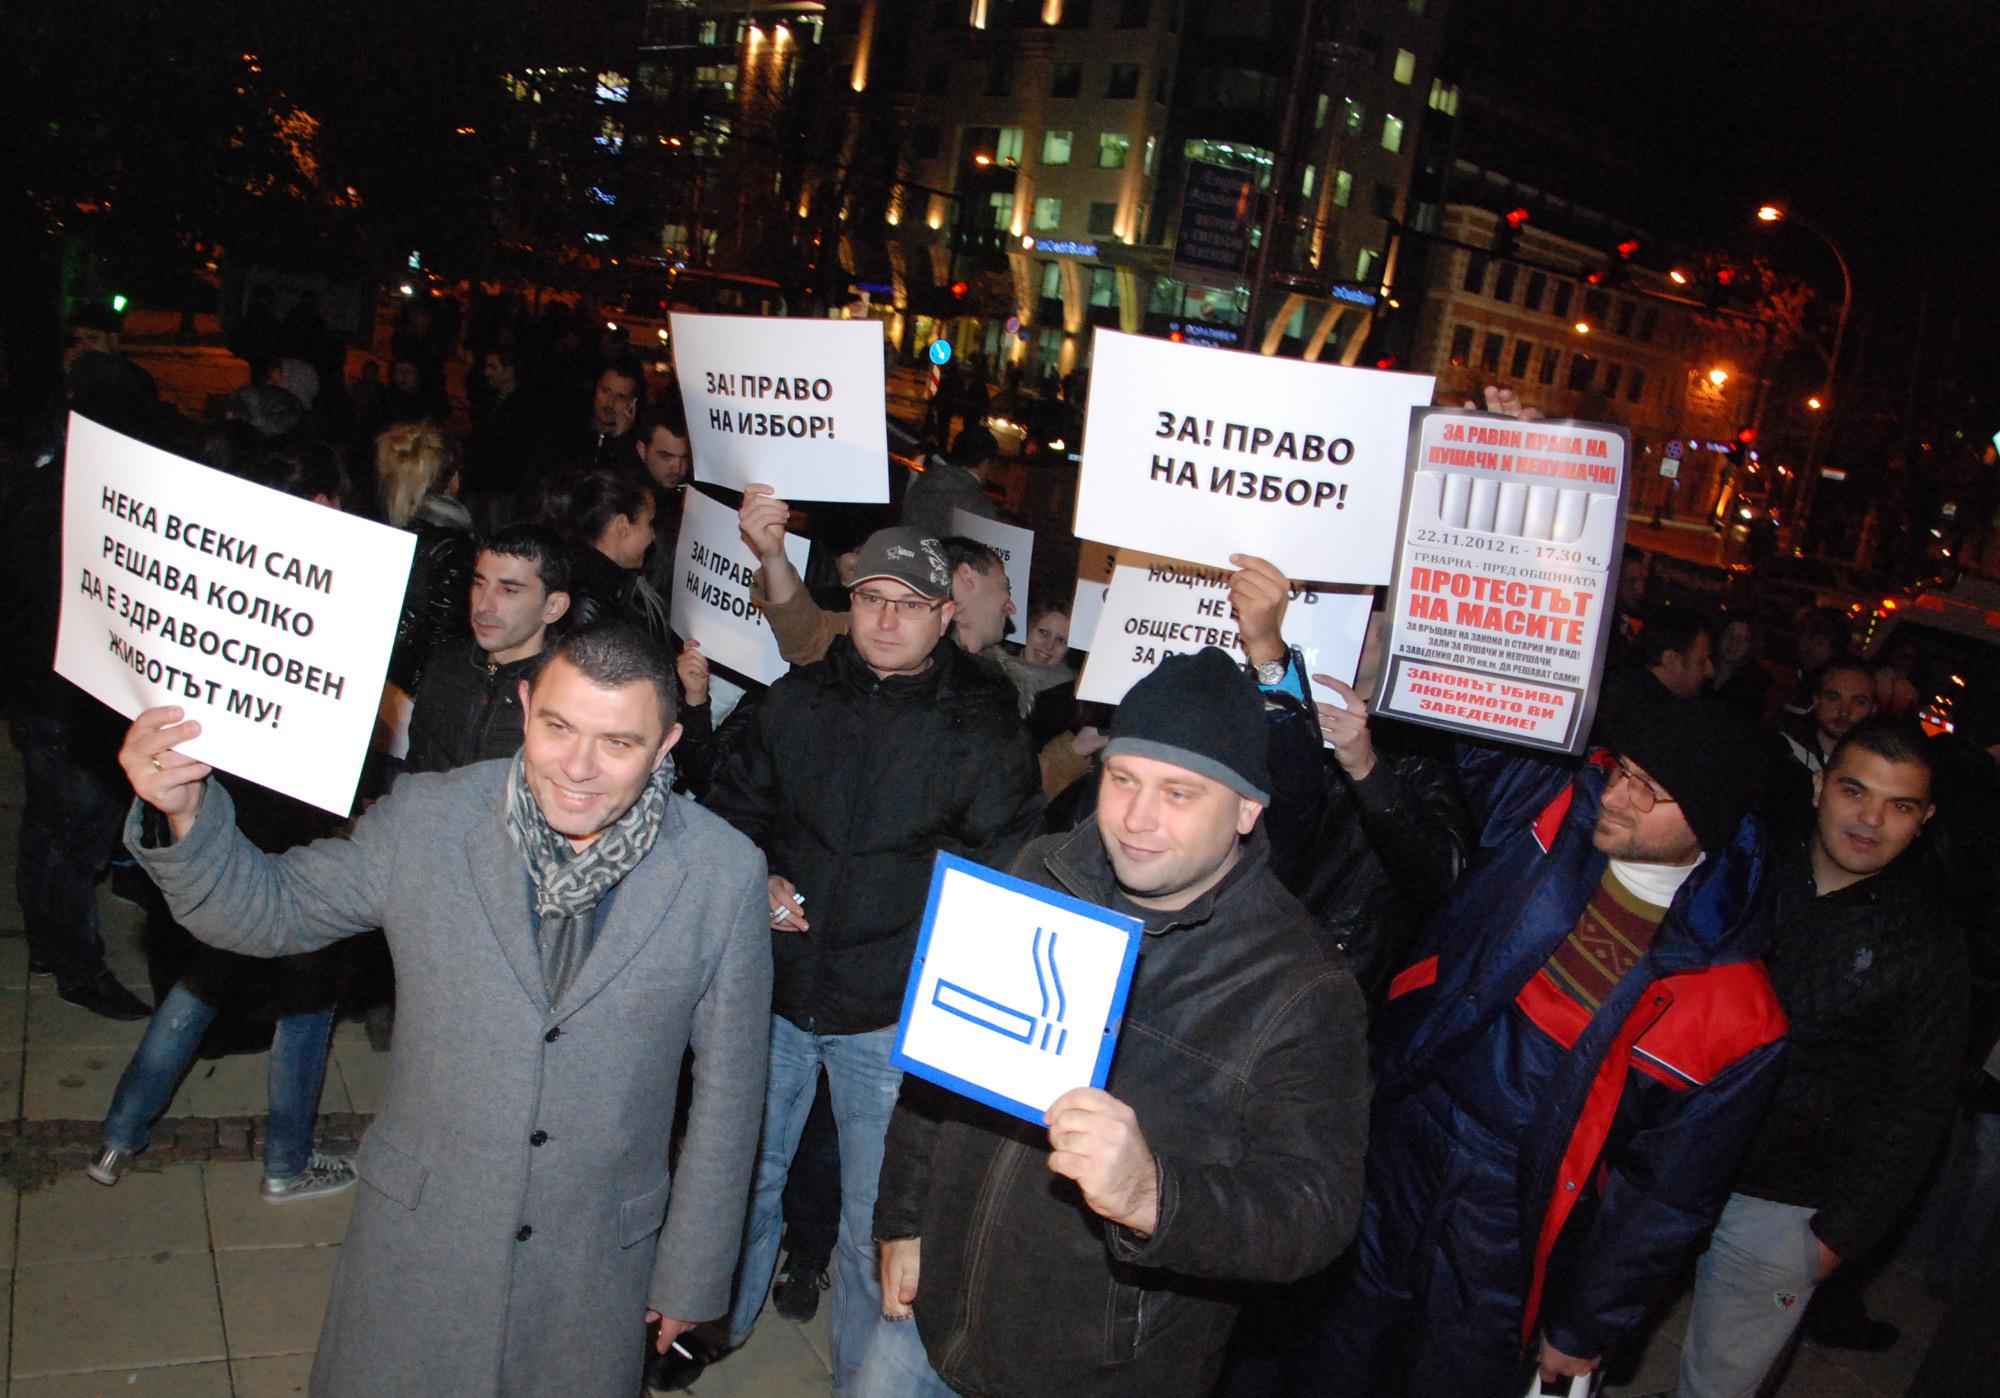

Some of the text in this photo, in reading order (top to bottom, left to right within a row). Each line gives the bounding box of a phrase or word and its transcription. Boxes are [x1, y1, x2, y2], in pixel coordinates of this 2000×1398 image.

[705, 372, 833, 402] ЗА! ПРАВО
[709, 408, 836, 440] НА ИЗБОР!
[1155, 411, 1355, 466] ЗА! ПРАВО
[1443, 423, 1465, 442] ЗА
[1467, 426, 1523, 449] РАВНИ
[1585, 439, 1608, 459] НА
[1428, 445, 1499, 472] ПУШАЧИ
[1500, 454, 1513, 472] И
[1151, 454, 1350, 510] НА ИЗБОР!
[101, 485, 334, 595] НЕКА ВСЕКИ САМ
[1417, 529, 1505, 553] 22.11.2012
[1535, 546, 1582, 564] 17.30
[1587, 556, 1601, 566] ч.
[690, 540, 754, 588] ЗА! ПРАВ
[1148, 564, 1231, 590] НОЩНИ
[1414, 552, 1473, 569] ГР.ВАРНА
[1483, 562, 1517, 577] ПРЕД
[1519, 569, 1597, 588] ОБЩИНАТА
[103, 535, 315, 638] РЕШАВА КОЛКО
[686, 570, 763, 626] НА ИЗБОР!
[1410, 566, 1594, 618] ПРОТЕСТЪТ
[1197, 597, 1226, 618] НЕ
[1409, 594, 1586, 646] НА МАСИТЕ
[81, 568, 347, 701] ДА Е ЗДРАВОСЛОВЕН
[1406, 621, 1581, 661] ЗА ВРЪЩАНЕ НА ЗАКОНА В СТАРИЯ МУ ВИД!
[1428, 637, 1553, 667] ЗАЛИ ЗА ПУШАЧИ И НЕПУШАЧИ.
[1132, 646, 1156, 665] ЗА
[1399, 644, 1405, 653] А
[1405, 645, 1452, 661] ЗАВЕДЕНИЯ
[1452, 653, 1466, 664] ДО
[1466, 655, 1476, 666] 70
[1499, 661, 1512, 673] ДА
[1512, 664, 1553, 680] РЕШАВАТ
[1553, 671, 1581, 684] САМИ!
[109, 630, 283, 729] ЖИВОТЪТ МУ!
[1407, 667, 1565, 707] ЗАКОНЪТ УБИВА
[1409, 682, 1556, 720] ЛЮБИМОТО ВИ
[1419, 698, 1538, 731] ЗАВЕДЕНИЕ!
